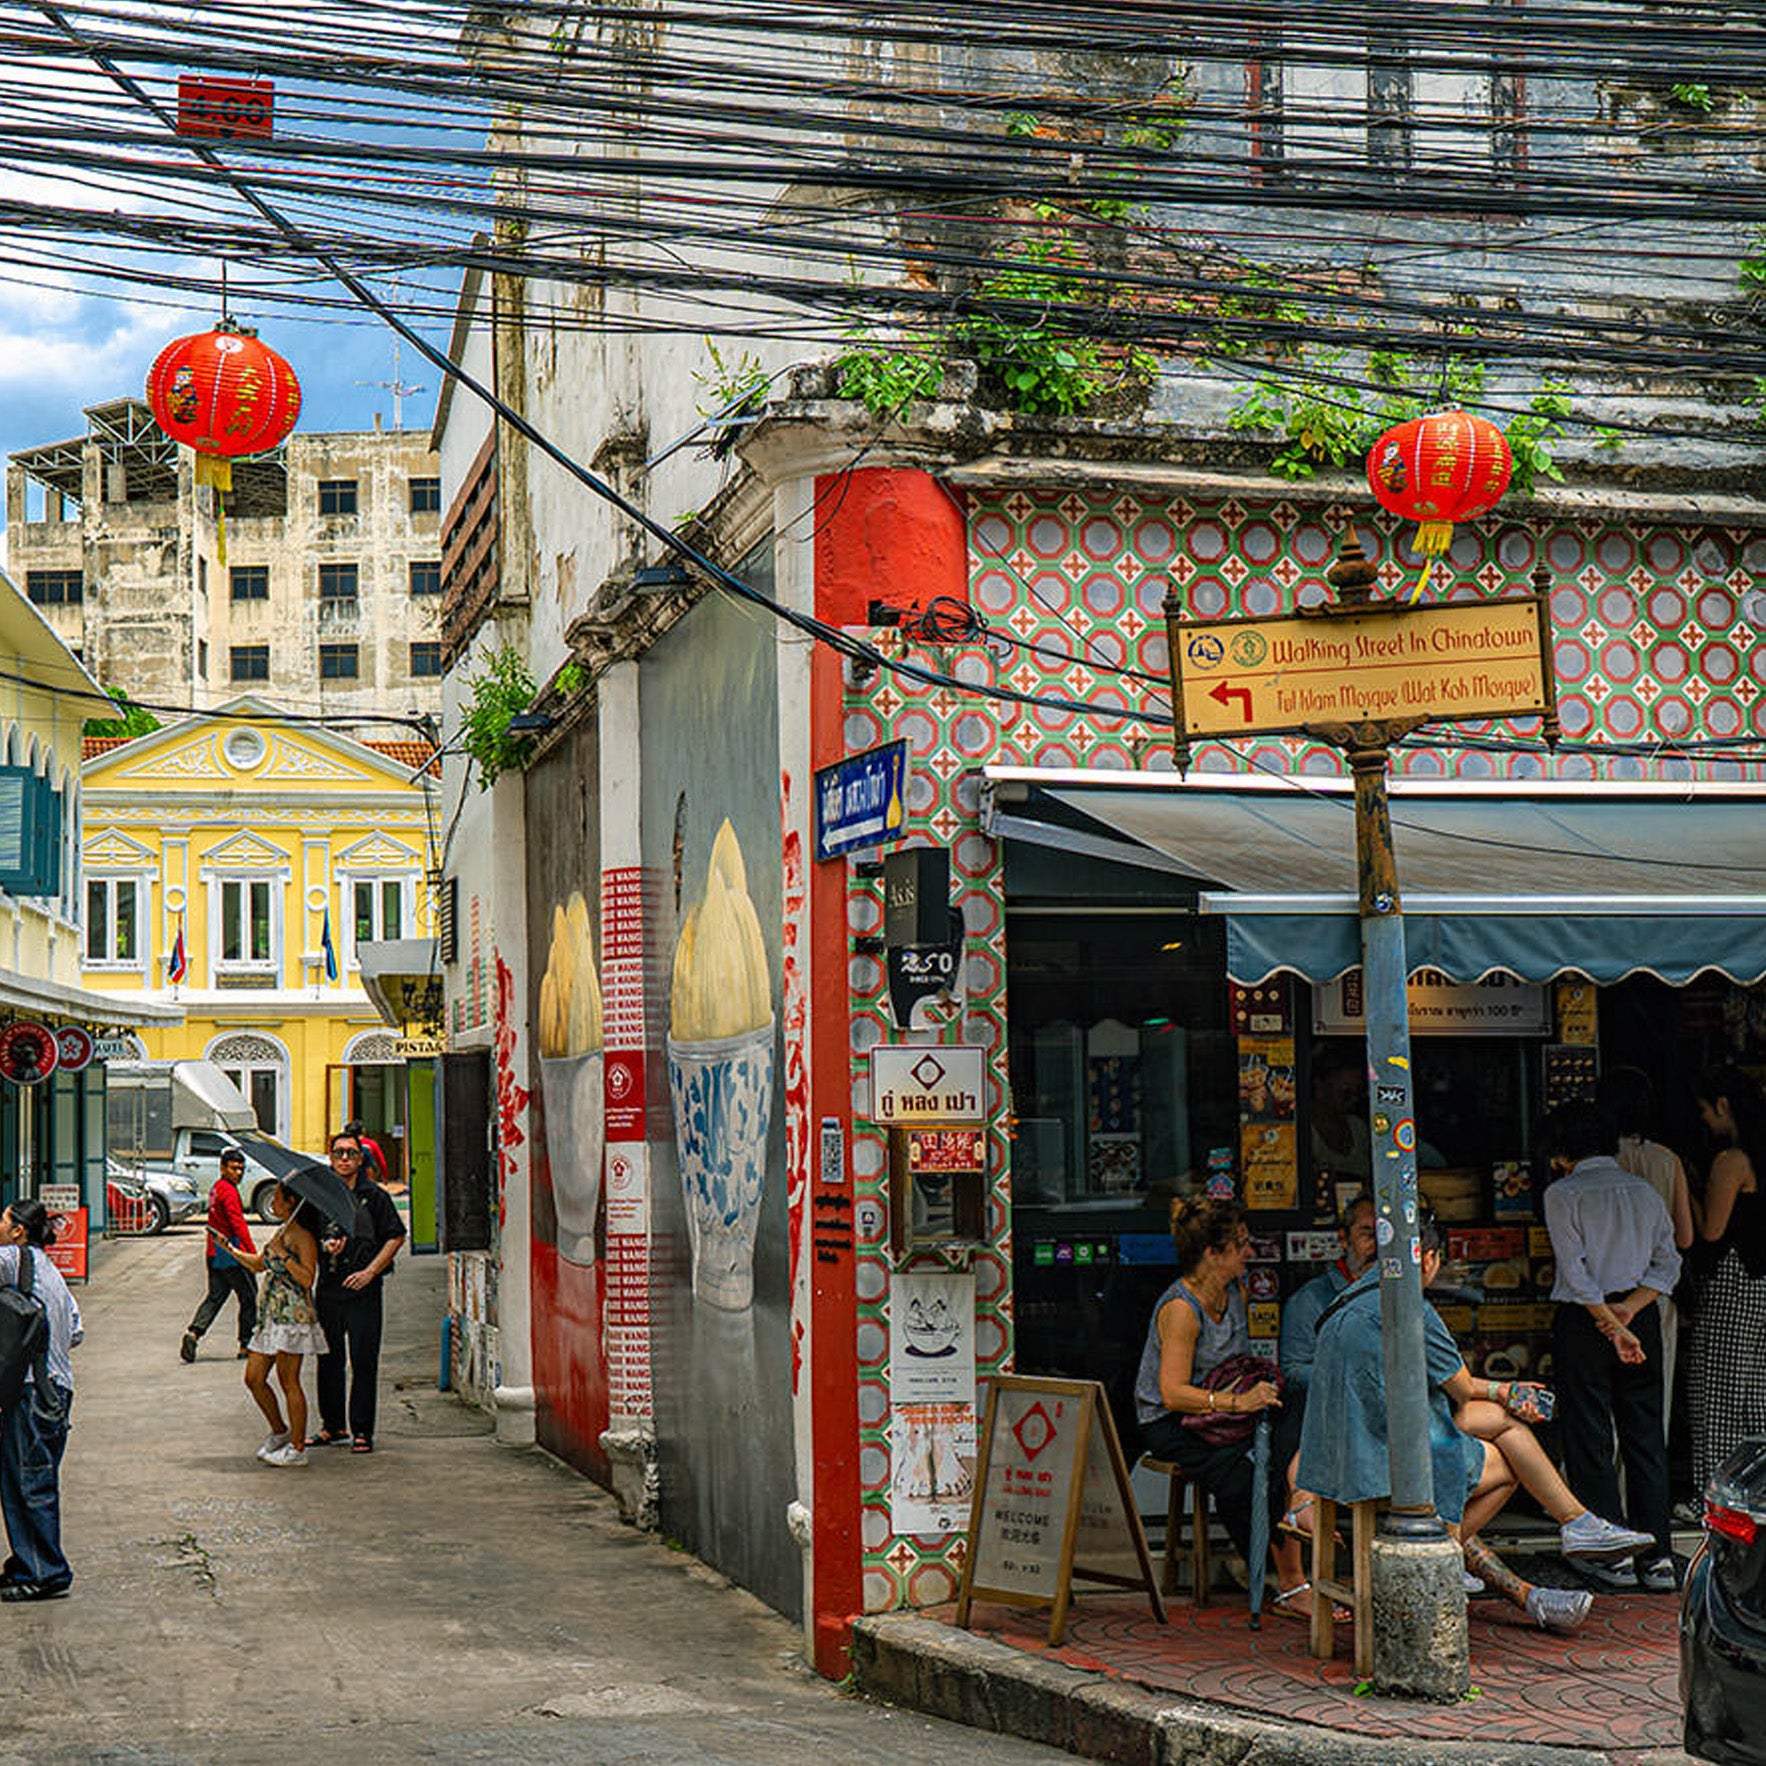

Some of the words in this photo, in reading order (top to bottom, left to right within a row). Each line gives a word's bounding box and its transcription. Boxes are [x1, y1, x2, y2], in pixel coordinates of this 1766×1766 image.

[1272, 637, 1352, 667] Walking
[1355, 632, 1405, 657] Street
[1410, 630, 1428, 653] In
[1431, 625, 1535, 653] Chinatown
[1340, 683, 1398, 713] Mosque
[1402, 680, 1436, 705] (Wat
[1441, 677, 1469, 701] Koh
[1473, 672, 1537, 702] Mosque)
[1487, 1004, 1509, 1017] 100
[881, 1089, 894, 1117] กู่
[901, 1094, 939, 1111] หลง
[945, 1091, 976, 1111] เปา
[995, 1510, 1050, 1527] WELCOME
